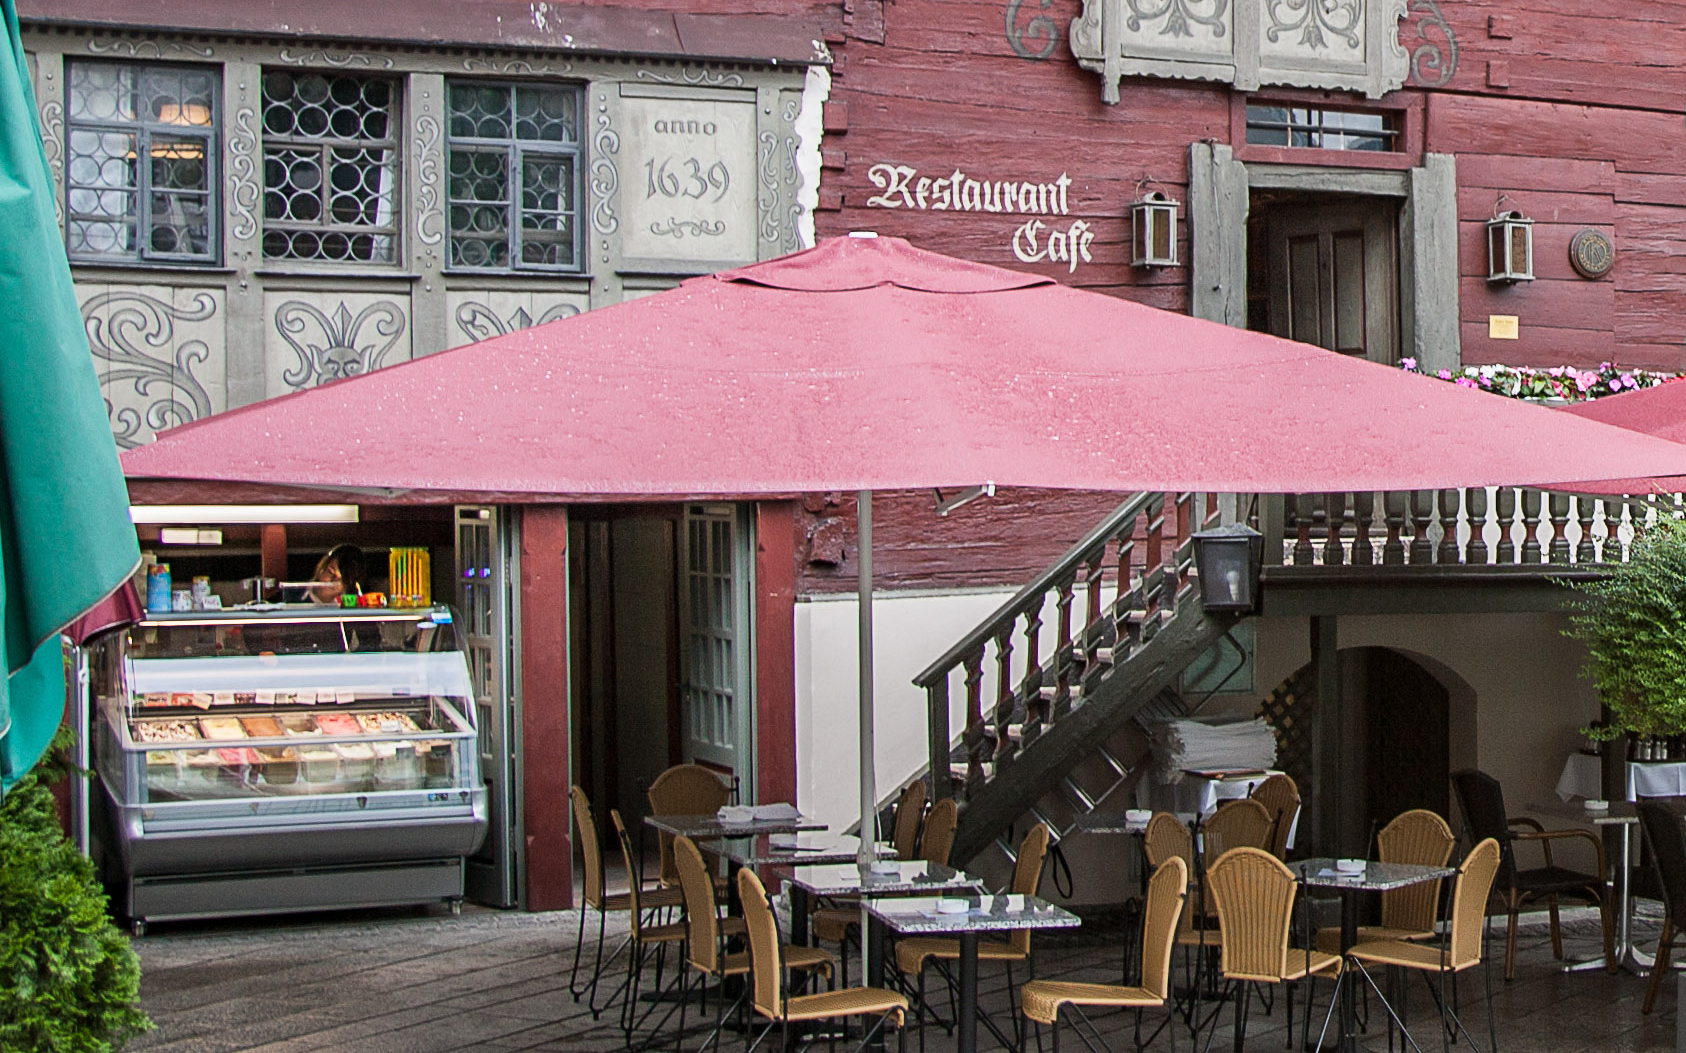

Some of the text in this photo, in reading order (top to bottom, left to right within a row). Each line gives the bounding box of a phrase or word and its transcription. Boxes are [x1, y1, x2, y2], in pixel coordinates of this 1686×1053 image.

[654, 119, 718, 135] anno
[645, 156, 730, 204] 1639
[866, 163, 1073, 215] Restaurant
